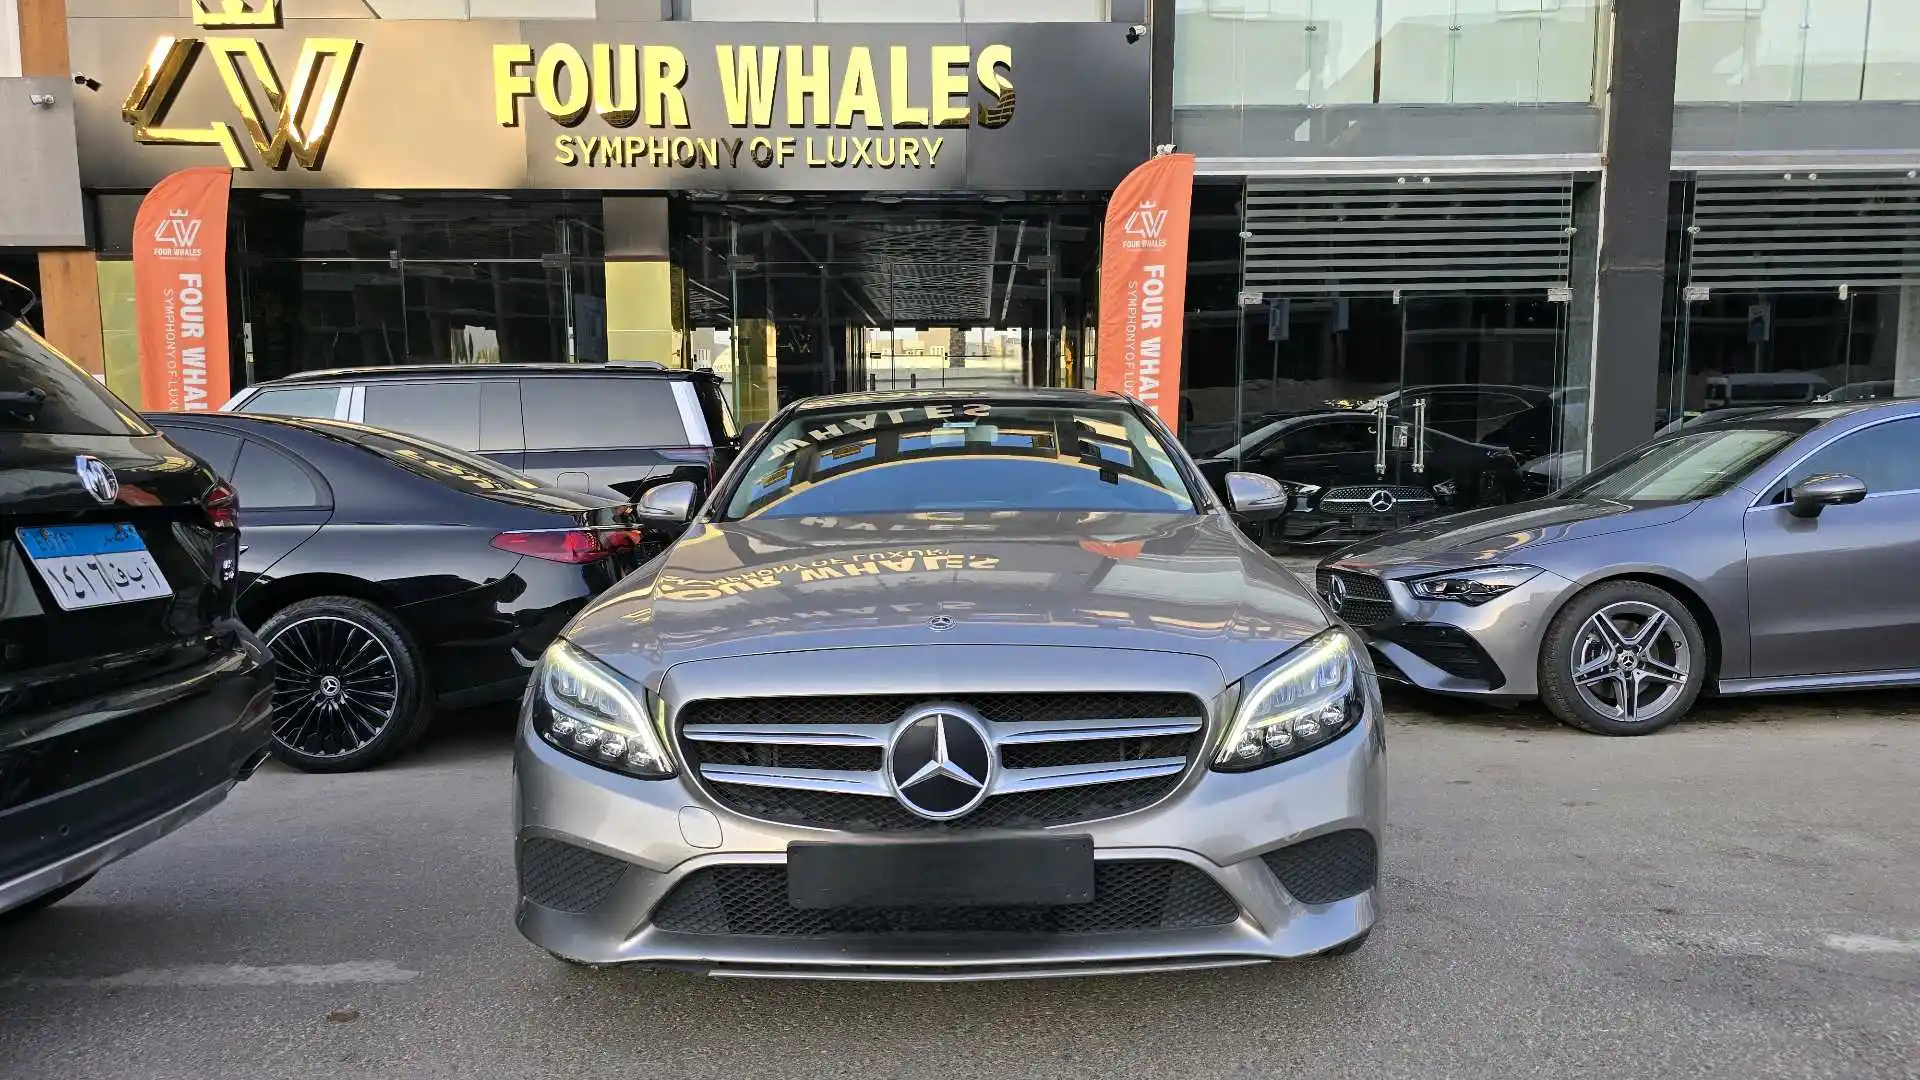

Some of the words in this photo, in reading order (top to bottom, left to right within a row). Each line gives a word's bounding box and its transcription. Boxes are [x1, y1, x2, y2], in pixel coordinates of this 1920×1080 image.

[492, 43, 688, 127] FOUR
[716, 43, 1016, 128] WHALES
[555, 135, 742, 167] SYMPHONY
[750, 136, 797, 167] OF
[806, 137, 944, 167] LUXURY
[163, 288, 176, 358] SYMPHONY
[179, 273, 204, 338] FOUR
[1125, 281, 1138, 352] SYMPHONY
[1141, 265, 1164, 329] FOUR
[166, 360, 178, 377] OF
[182, 347, 209, 412] WHAL
[1123, 373, 1135, 396] LUX
[1124, 353, 1136, 369] OF
[1138, 336, 1162, 410] WHAL
[167, 381, 178, 411] LUX
